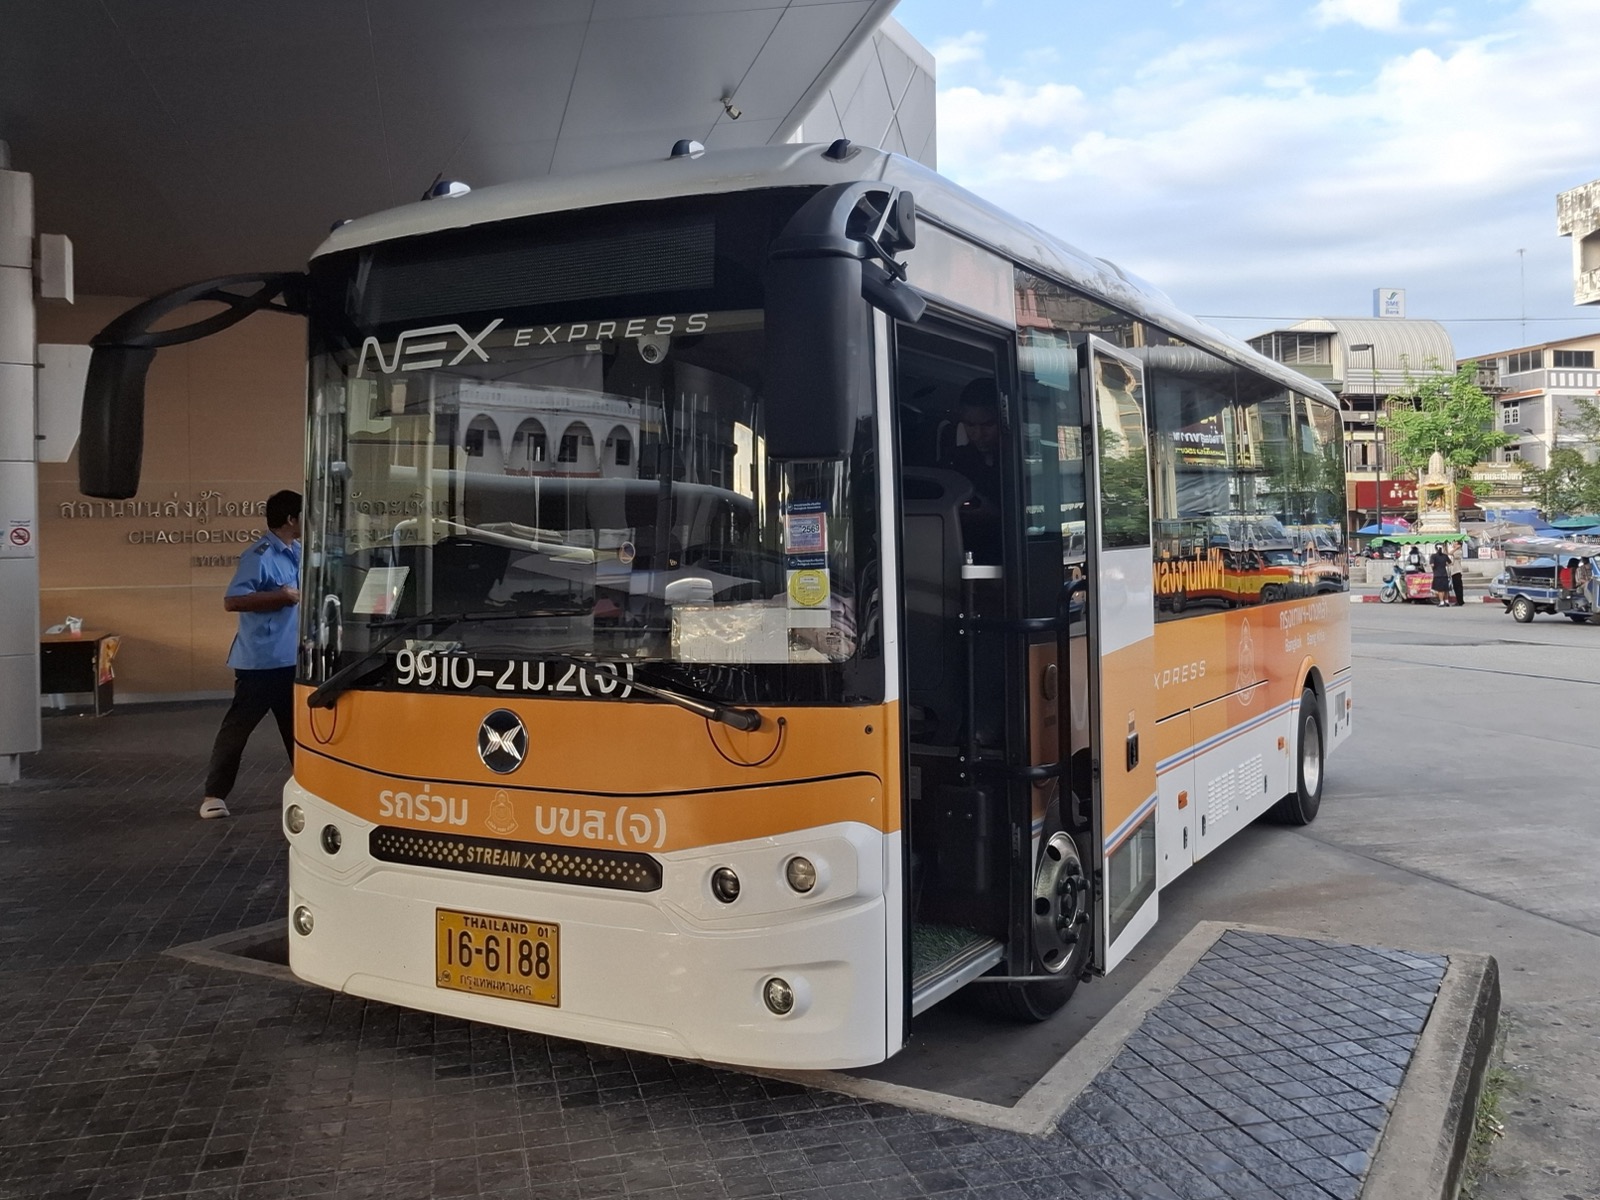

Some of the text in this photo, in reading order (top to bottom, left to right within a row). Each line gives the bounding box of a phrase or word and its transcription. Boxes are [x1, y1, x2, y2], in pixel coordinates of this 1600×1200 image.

[356, 313, 709, 378] NEX EXPRESS
[128, 529, 264, 544] CHACHOENGS
[1153, 660, 1207, 690] XPRESS
[379, 784, 667, 848] รถร่วม บขส.(จ)
[466, 847, 521, 868] STREAM
[463, 916, 549, 938] THAILAND 01
[447, 928, 551, 980] 16-6188
[460, 974, 532, 996] กรุงเทพมหานคร
